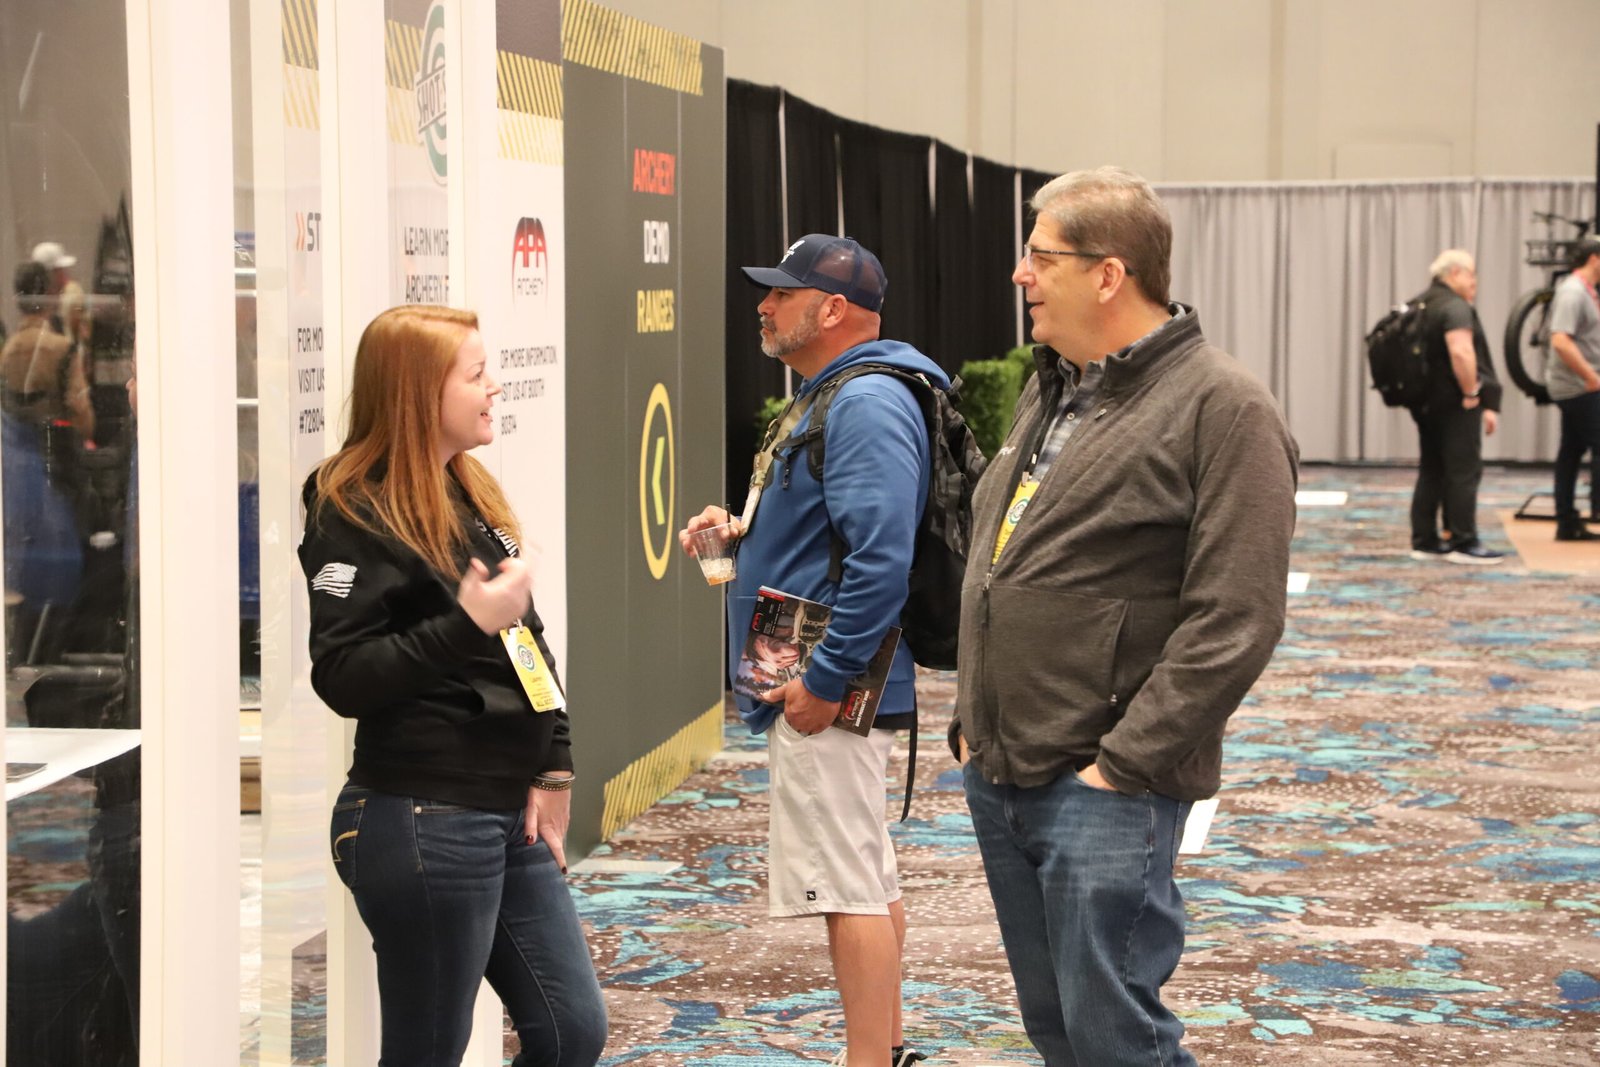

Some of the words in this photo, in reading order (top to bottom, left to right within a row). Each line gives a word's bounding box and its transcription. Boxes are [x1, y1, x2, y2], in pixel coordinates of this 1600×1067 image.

[417, 72, 440, 128] SHOT
[633, 148, 676, 196] ARCHERY
[307, 212, 321, 251] ST
[404, 226, 432, 256] LEARN
[511, 216, 548, 268] APA
[644, 220, 670, 264] DEMO
[405, 275, 443, 303] ARCHERY
[637, 289, 675, 333] RANGES
[297, 327, 311, 352] FOR
[510, 347, 525, 369] MORE
[298, 368, 315, 394] VISIT
